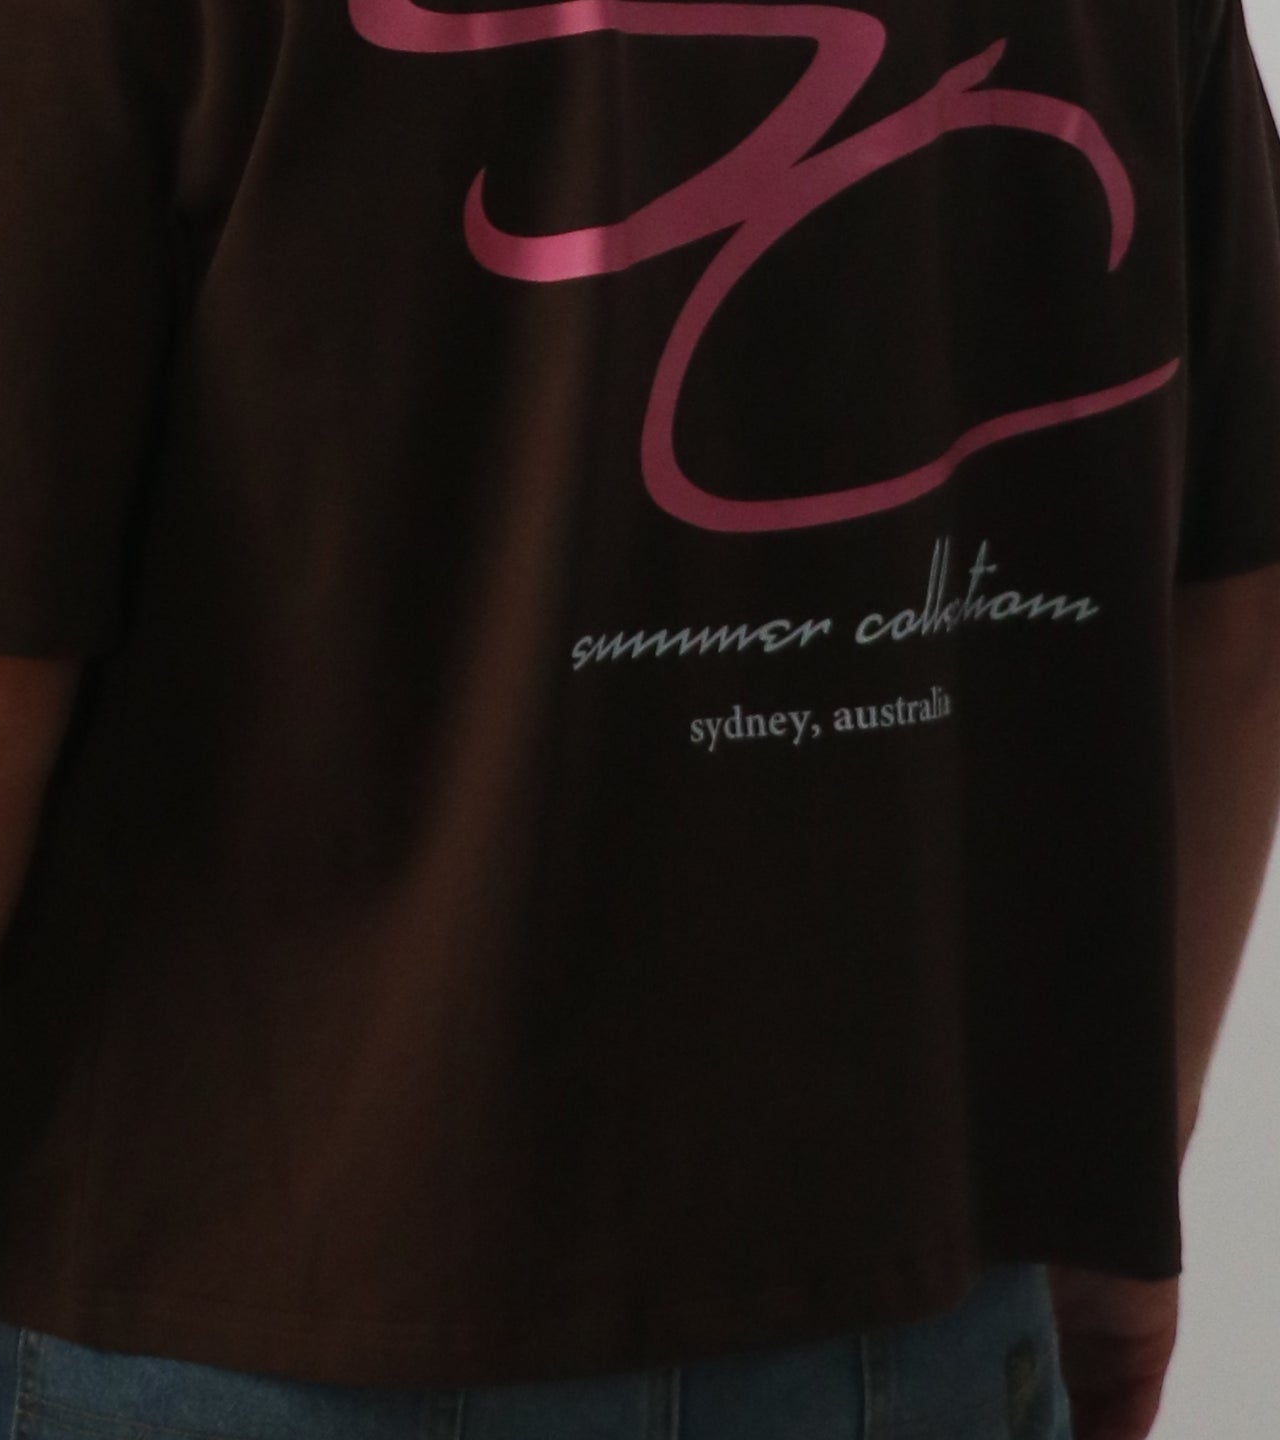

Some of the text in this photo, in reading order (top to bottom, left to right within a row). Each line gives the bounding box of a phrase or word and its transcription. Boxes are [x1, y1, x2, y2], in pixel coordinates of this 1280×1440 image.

[571, 618, 832, 671] summer
[689, 685, 952, 752] sydney, australia
